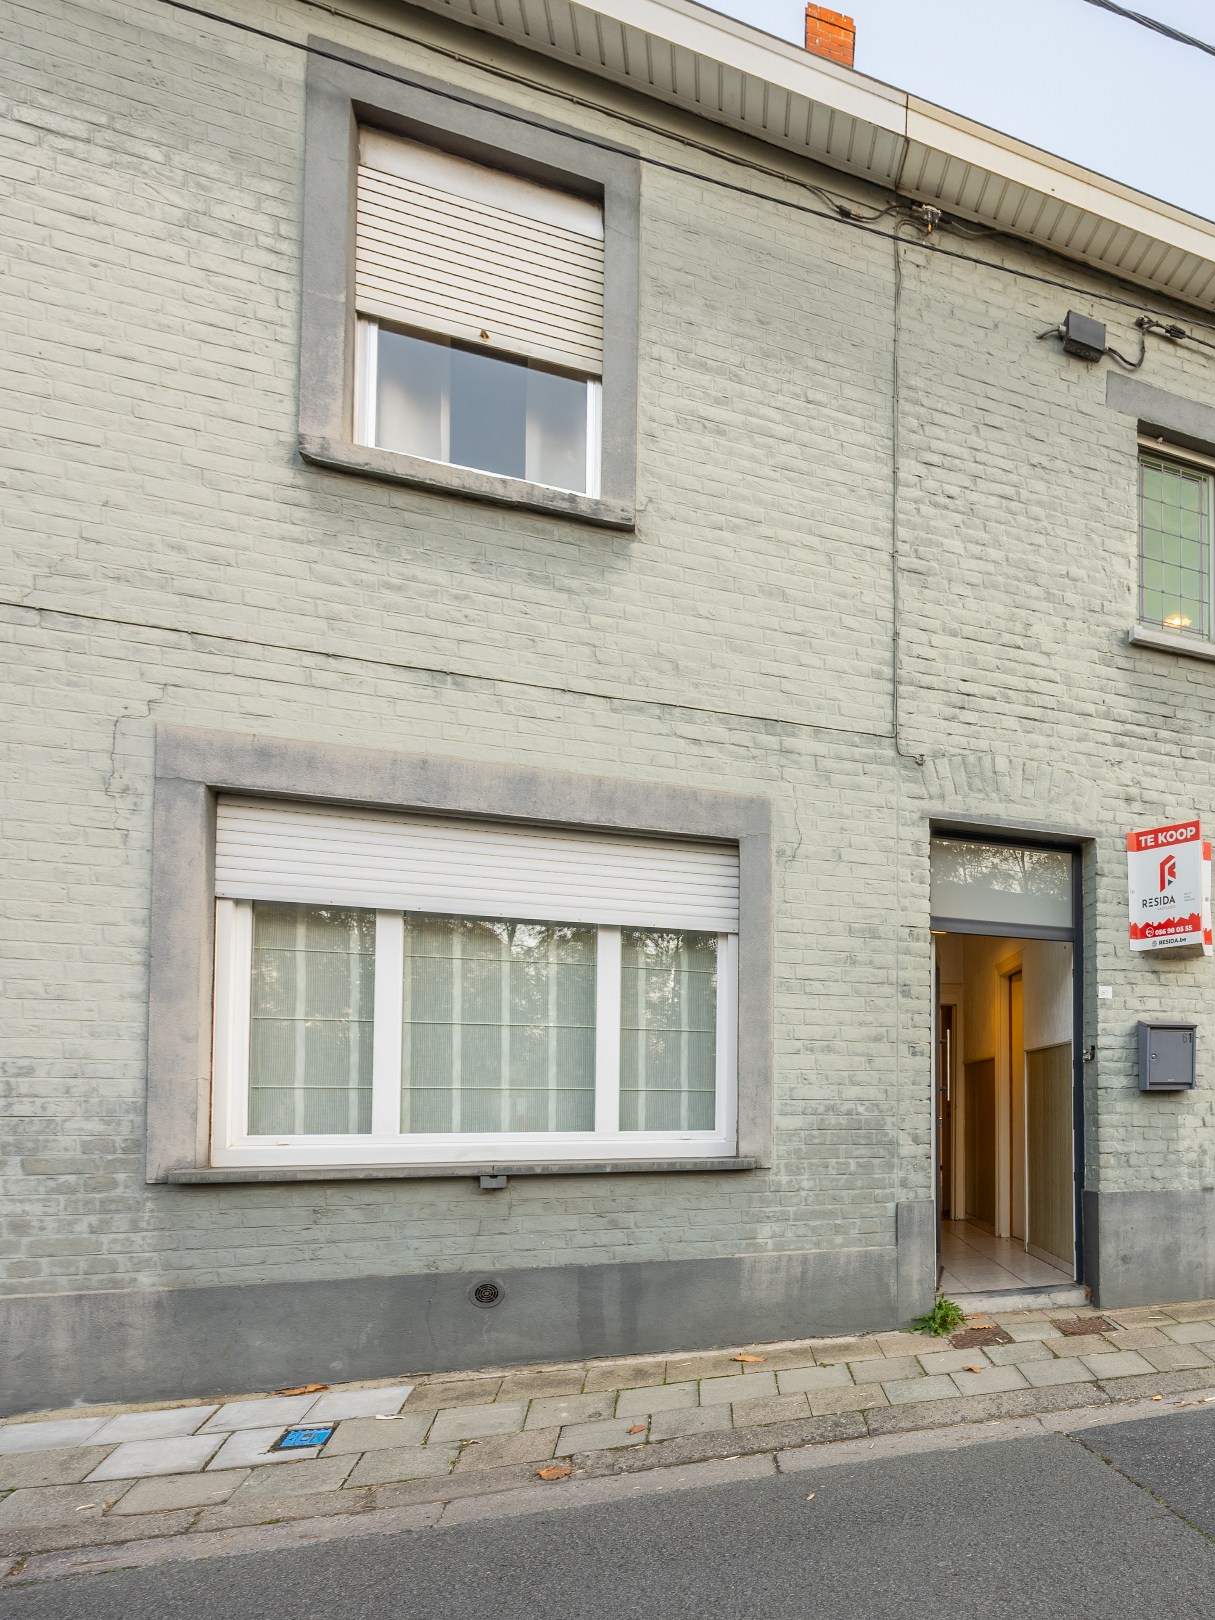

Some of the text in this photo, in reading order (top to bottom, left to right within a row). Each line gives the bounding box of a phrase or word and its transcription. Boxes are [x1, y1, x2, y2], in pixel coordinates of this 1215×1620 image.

[1138, 826, 1196, 848] TE KOOP
[1142, 896, 1176, 909] RESIDA
[1158, 937, 1187, 946] RESIDA.be
[1183, 1033, 1192, 1044] 61
